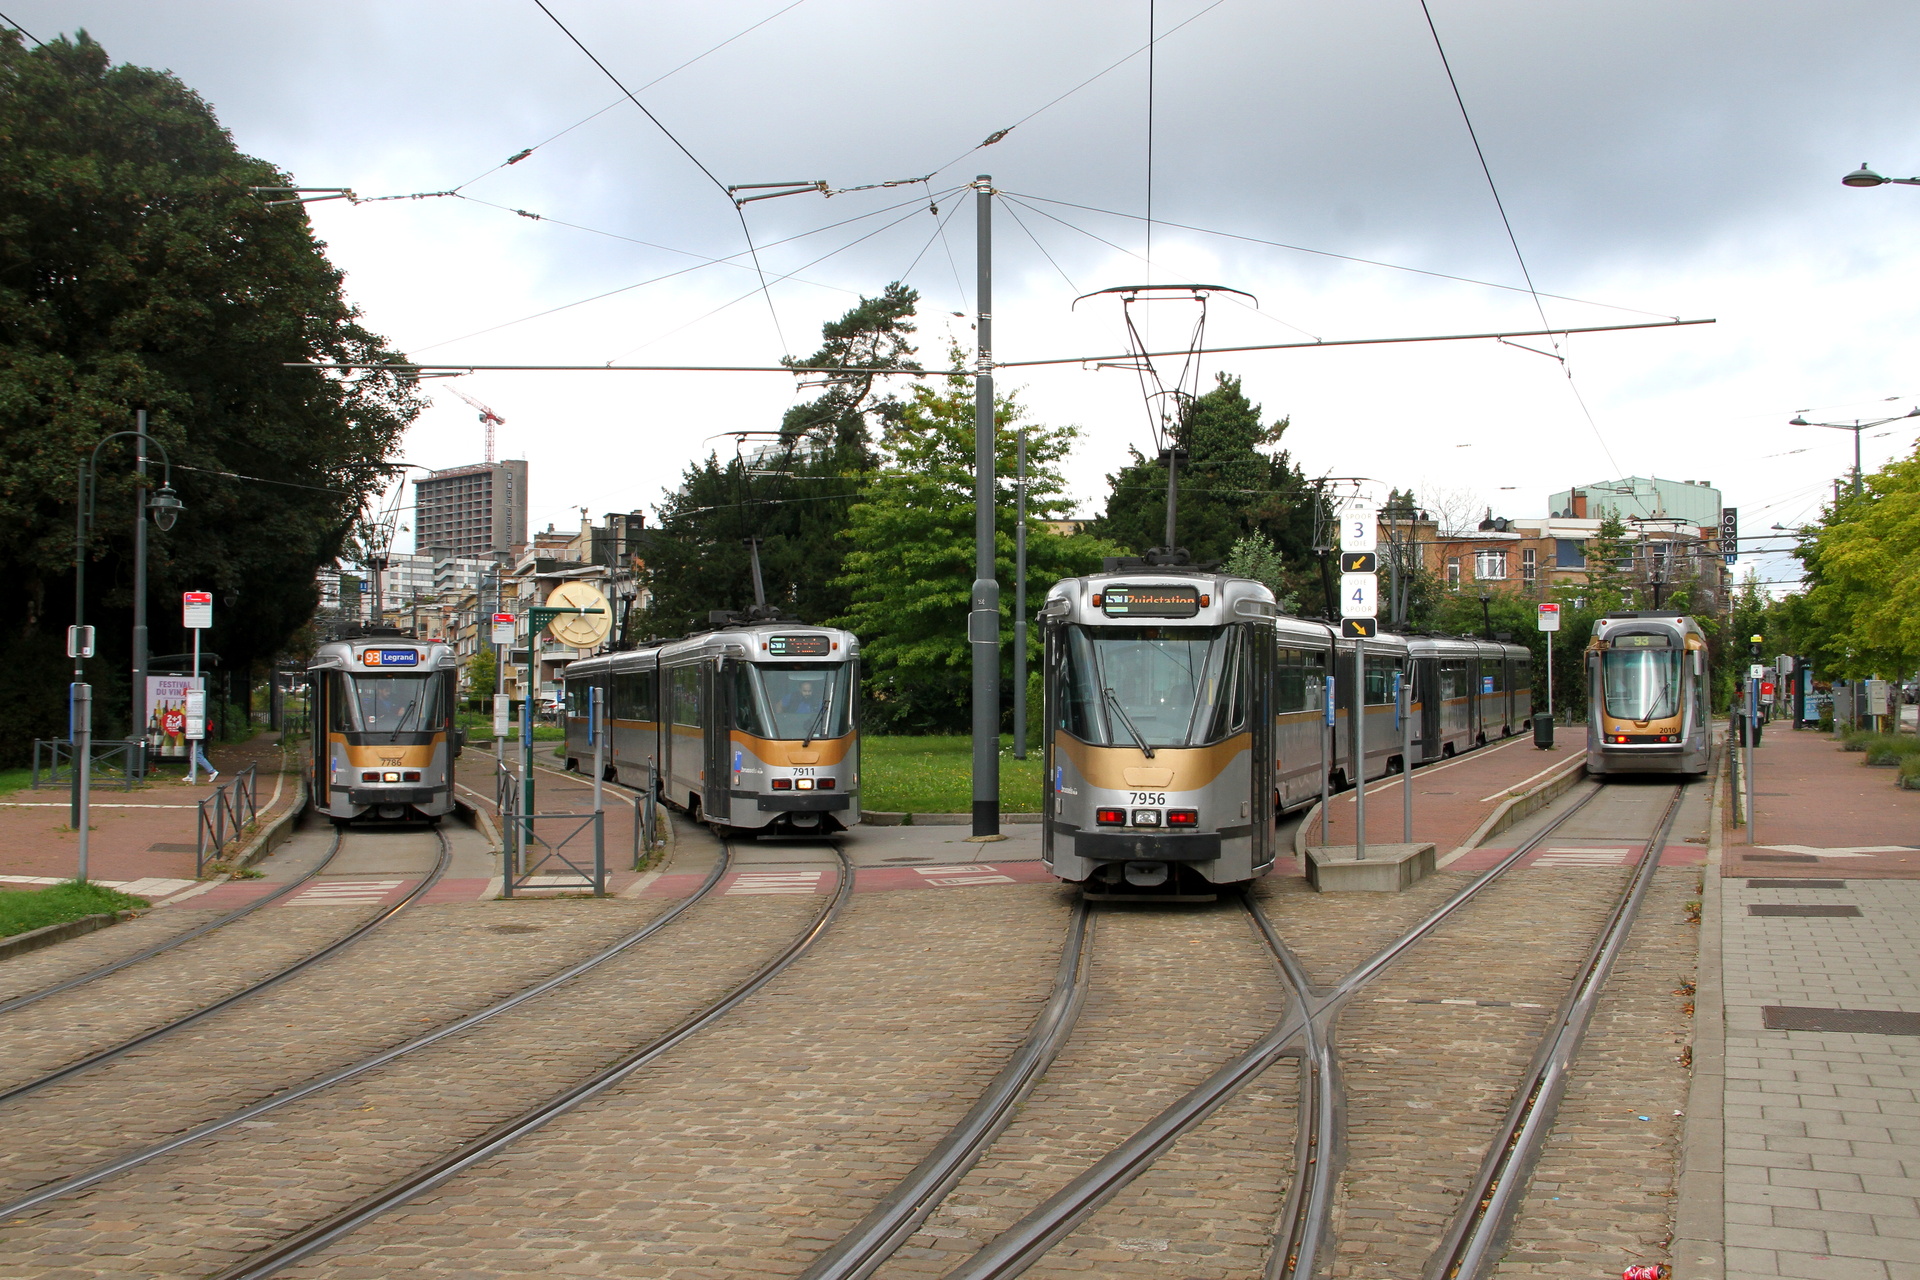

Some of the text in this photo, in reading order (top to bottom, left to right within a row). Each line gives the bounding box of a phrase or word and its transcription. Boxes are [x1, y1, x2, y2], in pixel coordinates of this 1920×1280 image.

[1353, 522, 1364, 538] 3
[1724, 515, 1735, 552] EXPO
[1128, 595, 1195, 604] Zuidstation
[1351, 588, 1364, 604] 4
[1634, 636, 1649, 646] 93
[365, 652, 414, 663] 93 Legrand
[156, 688, 166, 696] DU
[166, 714, 183, 723] 2+1
[792, 767, 815, 776] 7911
[1129, 792, 1166, 805] 7956
